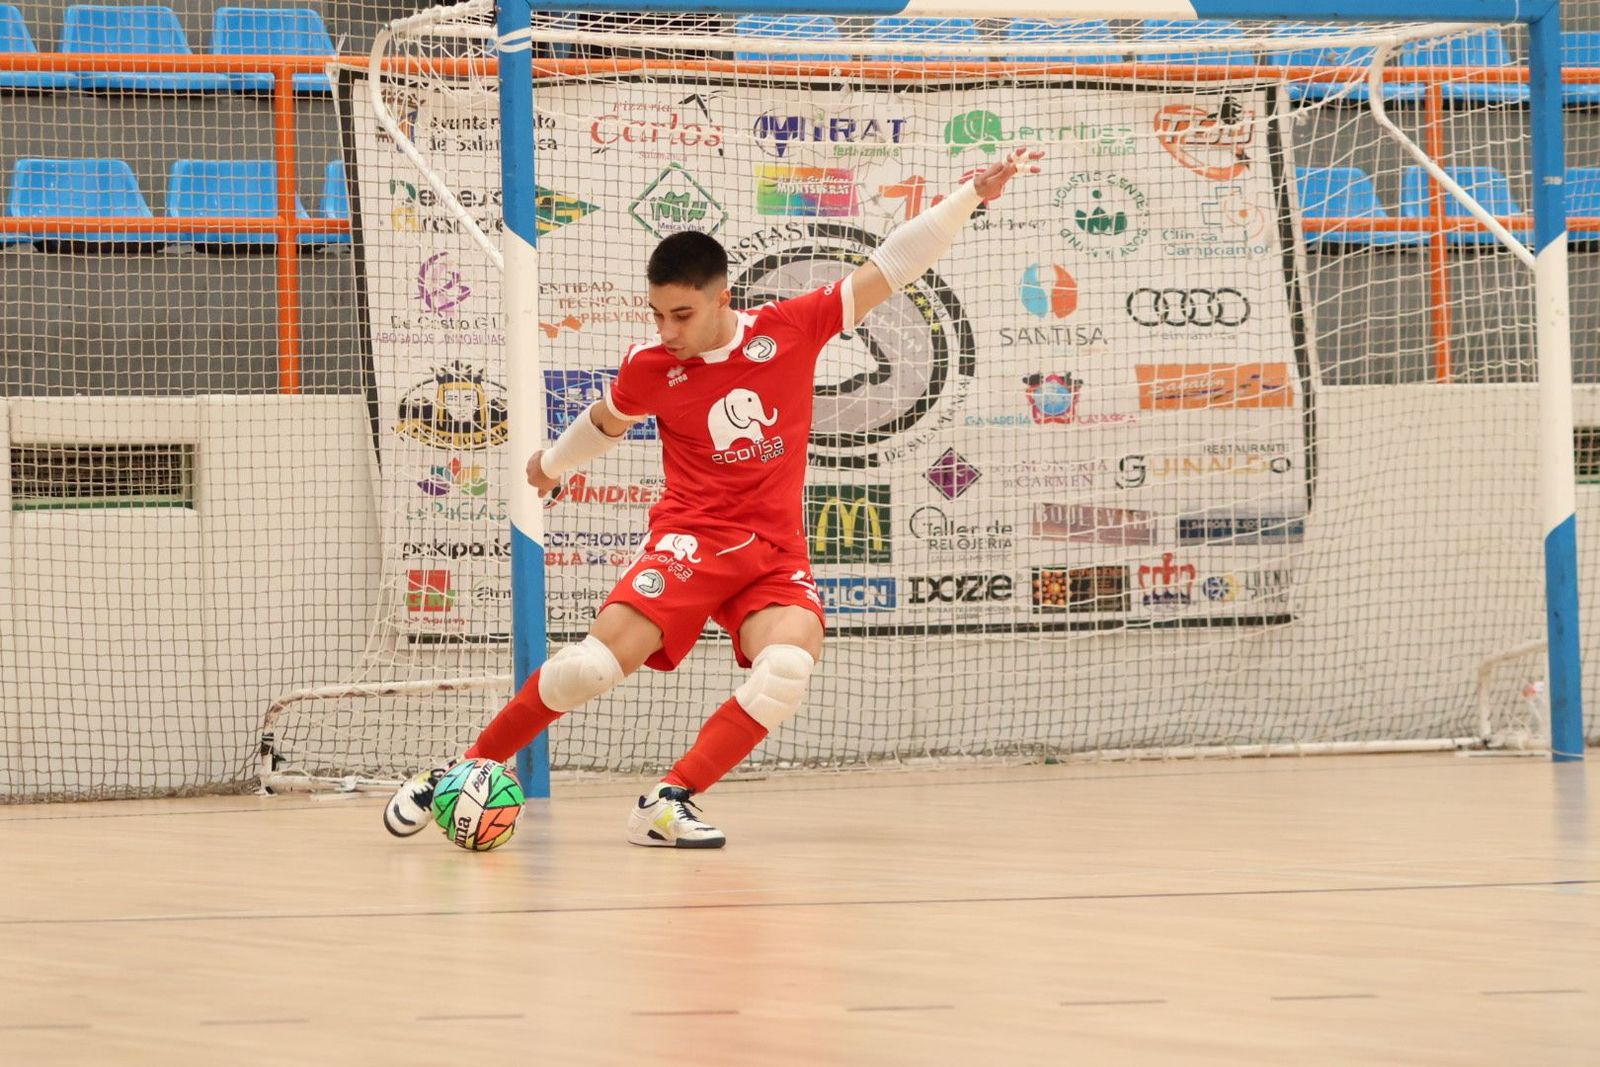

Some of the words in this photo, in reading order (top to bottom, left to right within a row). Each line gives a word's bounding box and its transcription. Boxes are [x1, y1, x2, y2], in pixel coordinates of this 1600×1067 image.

[429, 113, 557, 135] Ayuntamto
[590, 113, 723, 148] Carlos
[455, 135, 558, 152] Salaca
[580, 311, 657, 325] PREVENC
[1000, 327, 1108, 346] SANTISA
[1203, 443, 1290, 454] RESTAURANTE
[1015, 476, 1094, 488] CARMEN
